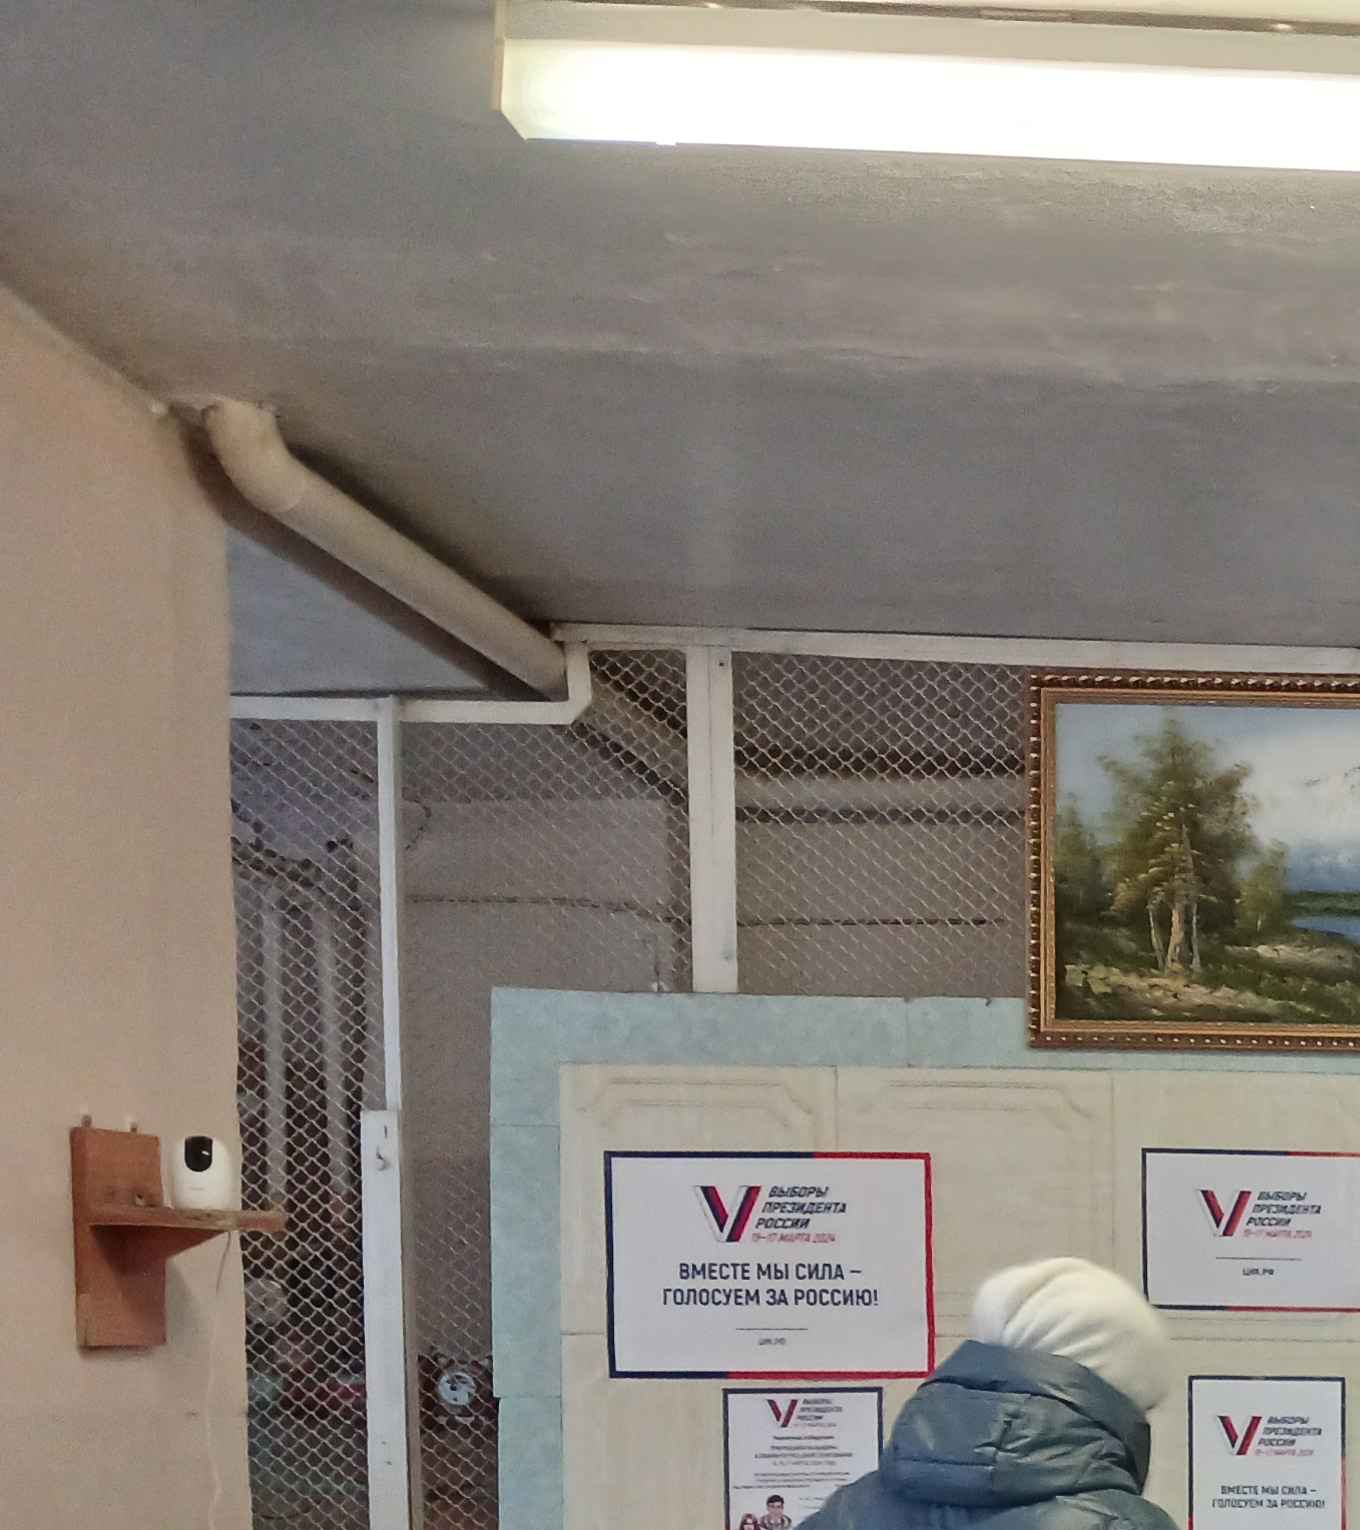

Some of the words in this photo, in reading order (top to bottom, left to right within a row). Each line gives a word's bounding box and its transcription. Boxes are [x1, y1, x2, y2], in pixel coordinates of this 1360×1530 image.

[768, 1186, 829, 1198] ВЫБОРЫ
[761, 1202, 847, 1215] ПРЕЗИДЕНТА
[755, 1218, 811, 1229] РОССИИ
[1246, 1216, 1291, 1227] РОССИИ
[679, 1262, 751, 1281] ВМЕСТЕ
[756, 1262, 790, 1281] МЫ
[795, 1262, 845, 1281] СИЛА
[662, 1288, 760, 1307] ГОЛОСУЕМ
[766, 1288, 789, 1307] ЗА
[794, 1288, 879, 1307] РОССИЮ!
